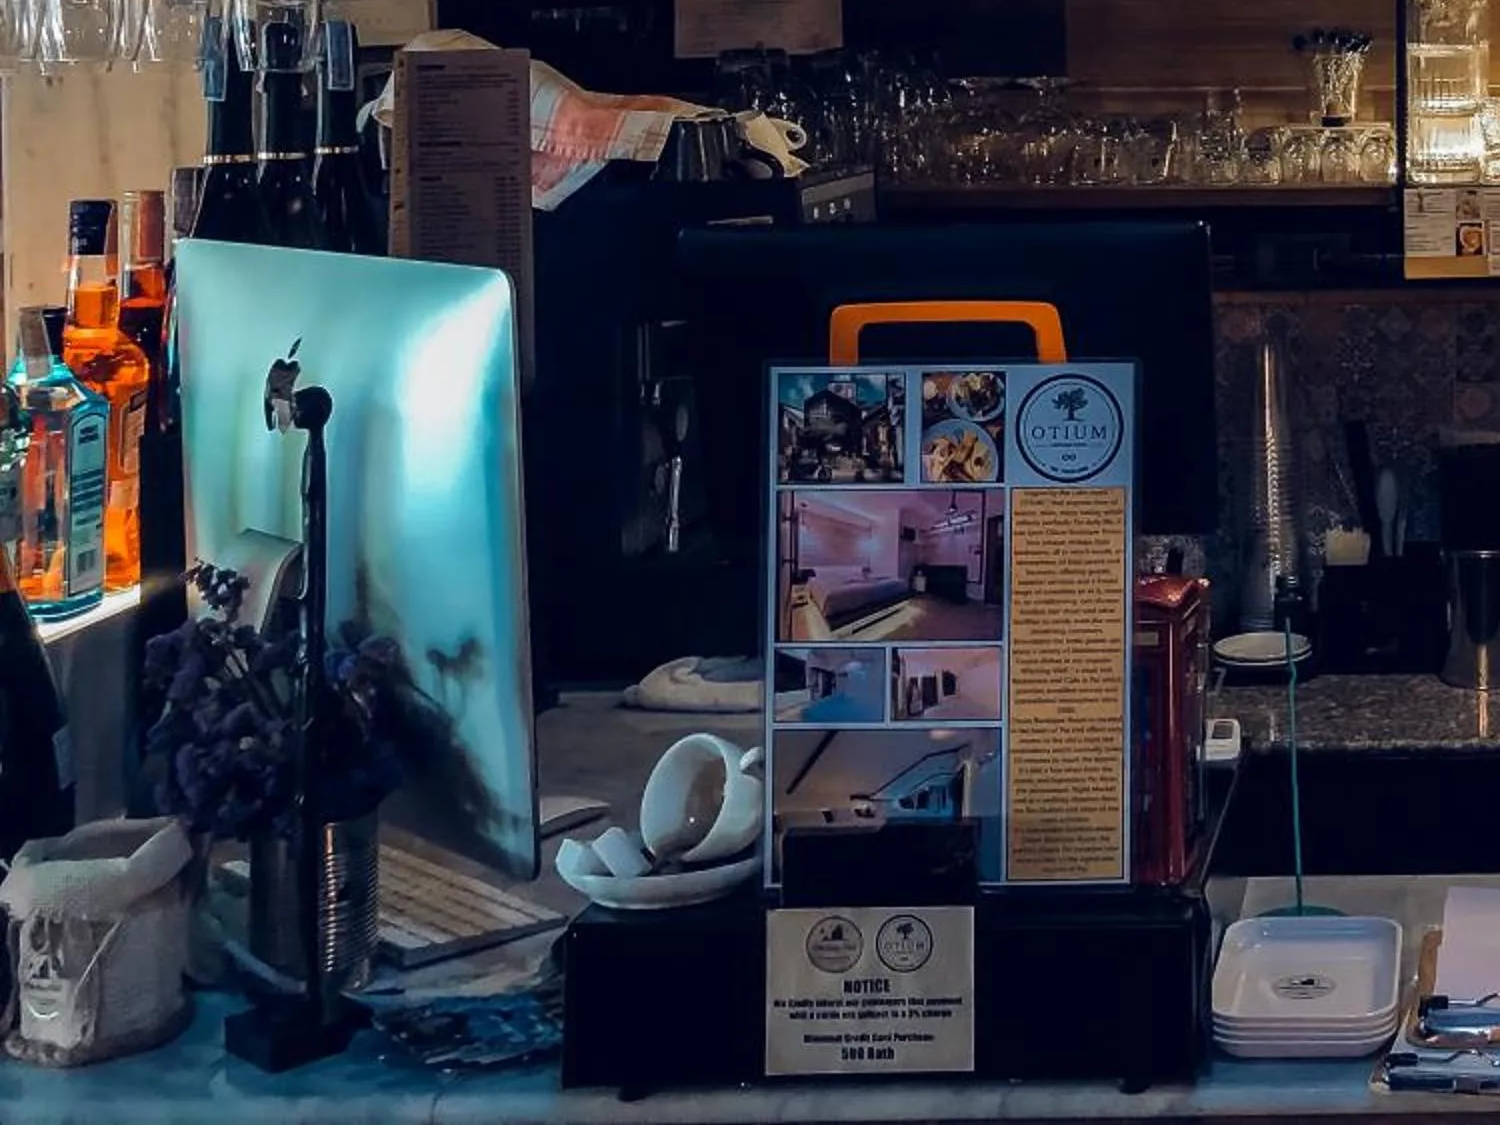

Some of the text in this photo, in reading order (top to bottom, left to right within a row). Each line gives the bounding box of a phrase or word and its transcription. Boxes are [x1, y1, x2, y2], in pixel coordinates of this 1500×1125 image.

[1031, 426, 1107, 440] OTIUM
[843, 978, 891, 993] NOTICE
[841, 1046, 865, 1060] 500
